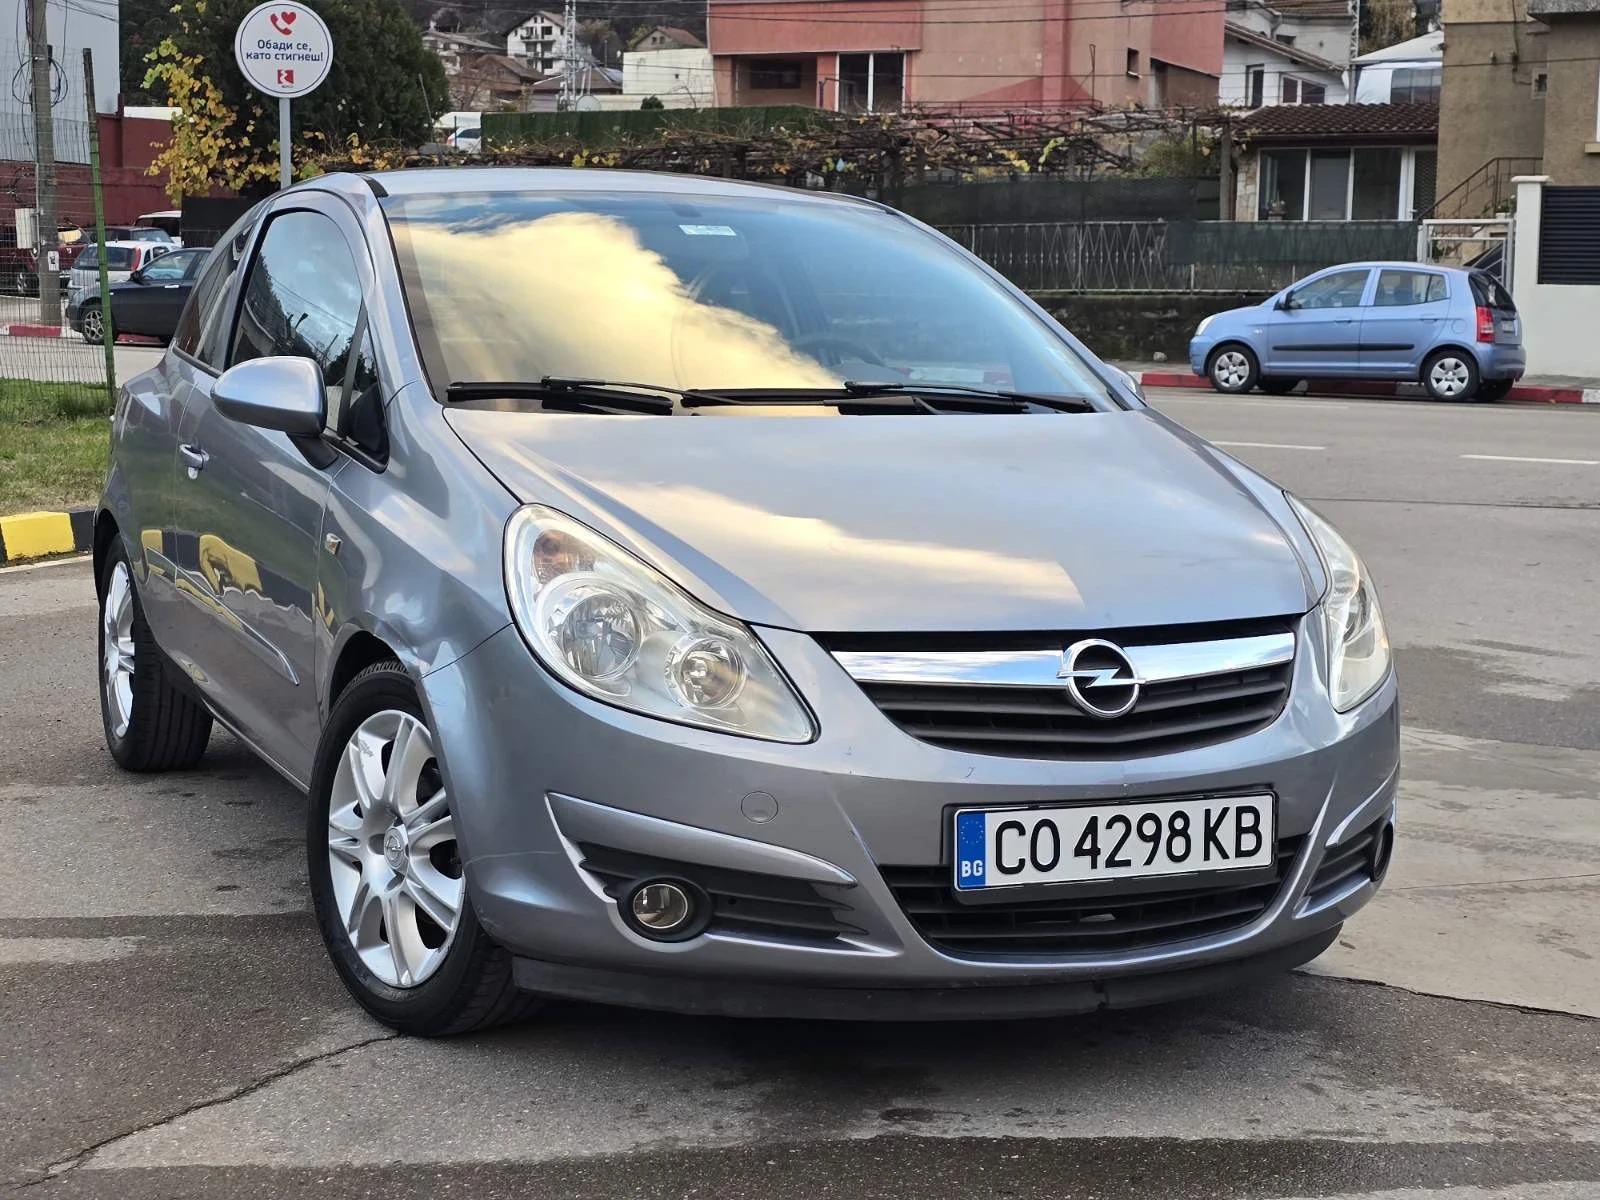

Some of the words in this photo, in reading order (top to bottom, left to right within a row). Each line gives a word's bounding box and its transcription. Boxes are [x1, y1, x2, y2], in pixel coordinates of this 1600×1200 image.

[257, 39, 293, 51] Обади
[296, 42, 312, 52] се,
[246, 51, 271, 60] като
[274, 52, 324, 62] стигнеш!
[995, 818, 1061, 875] CO
[1073, 809, 1192, 870] 4298
[1203, 805, 1263, 862] KB
[961, 860, 983, 878] BG
